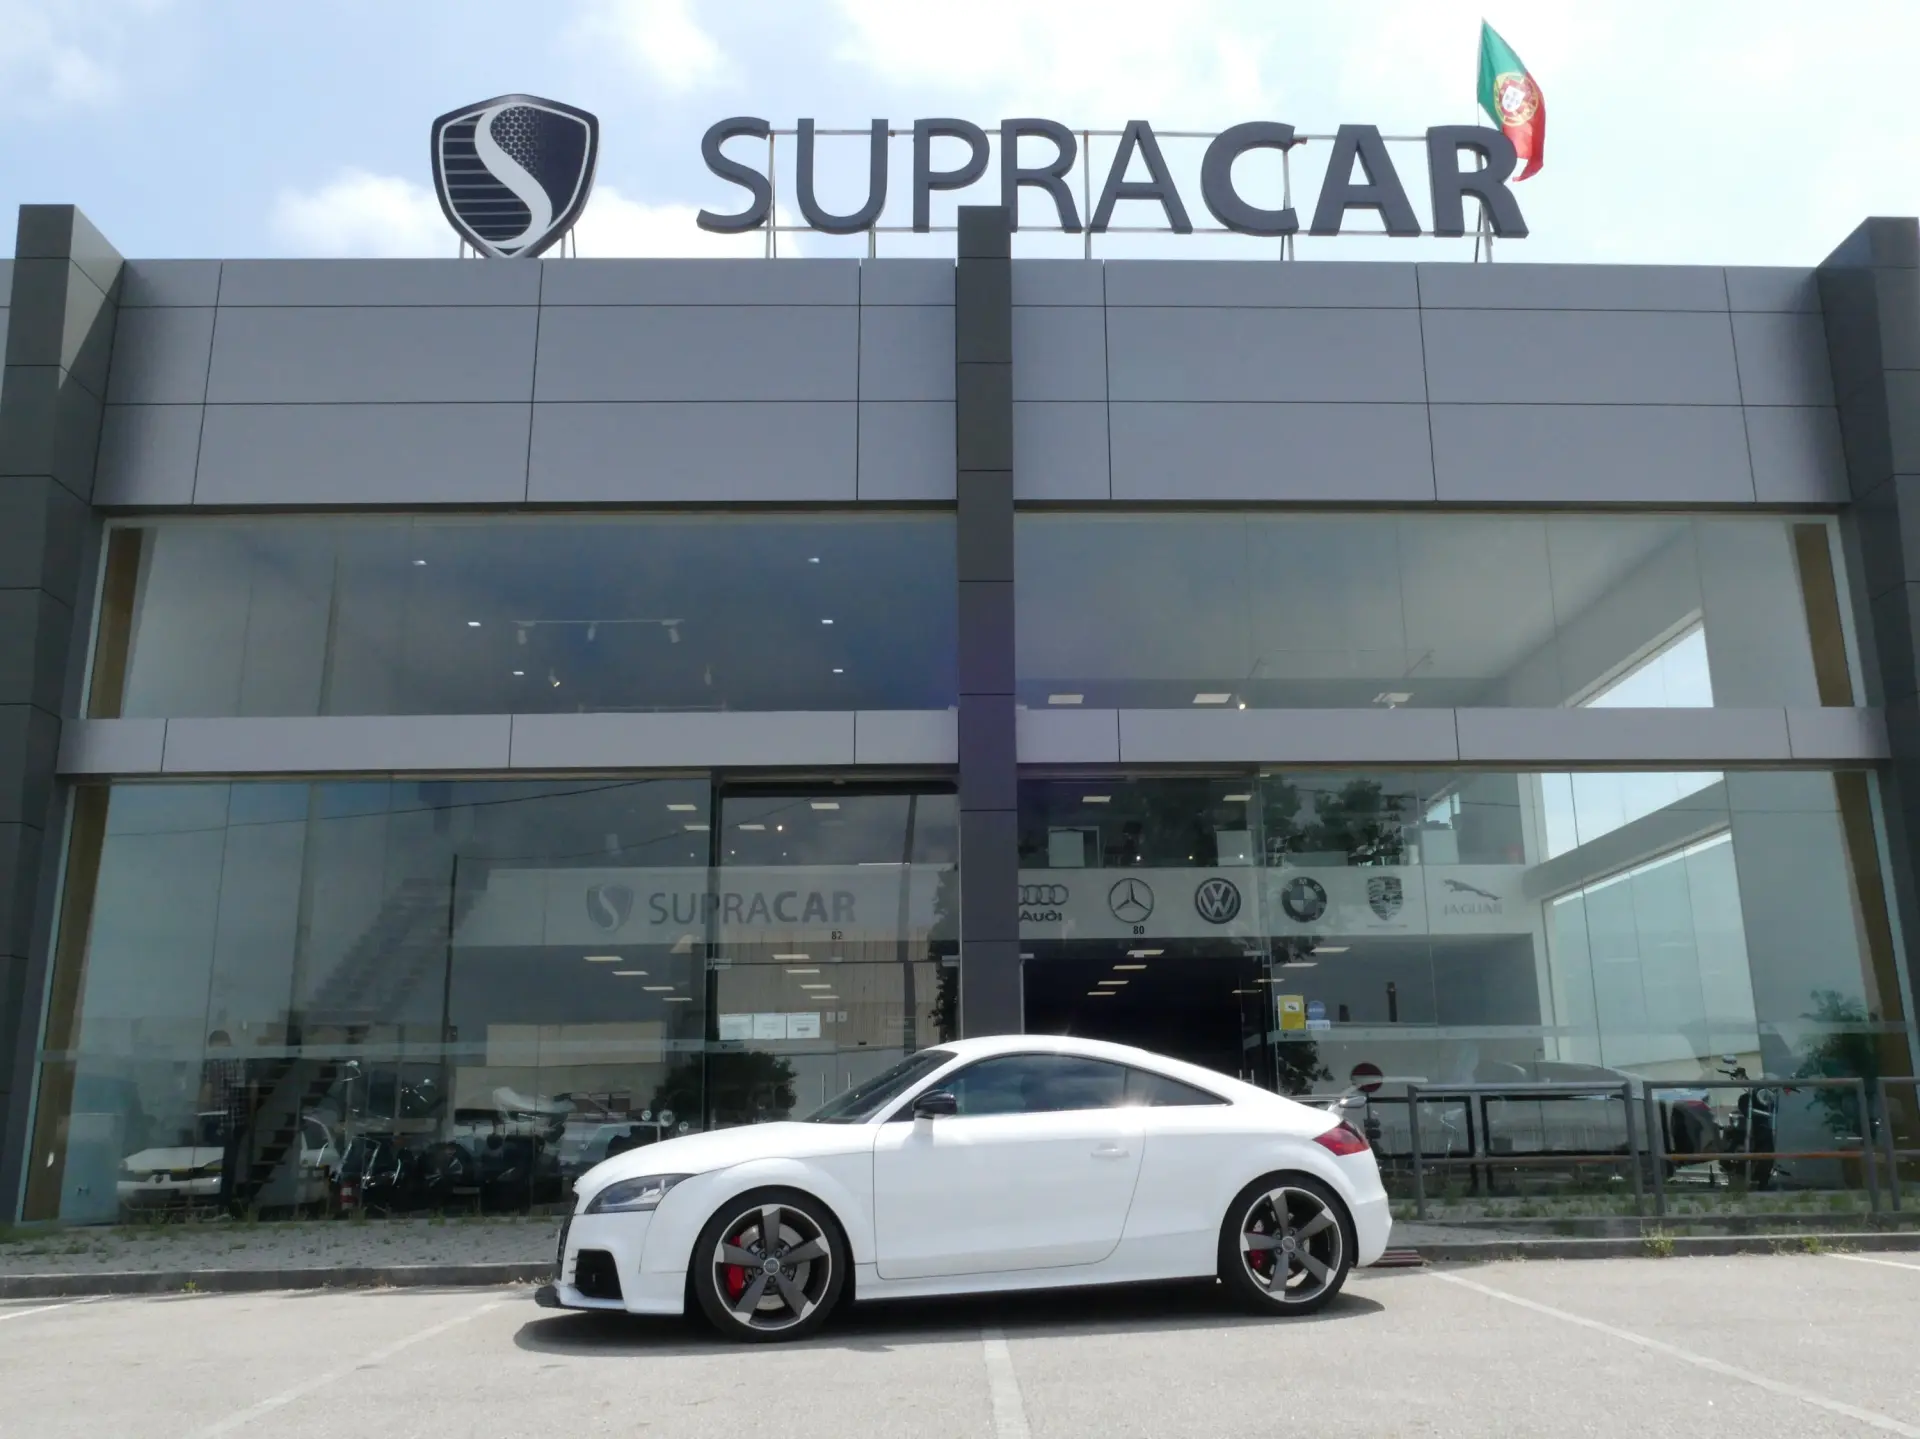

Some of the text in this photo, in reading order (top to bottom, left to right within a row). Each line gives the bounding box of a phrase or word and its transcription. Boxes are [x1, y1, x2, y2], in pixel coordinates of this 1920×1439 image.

[696, 116, 1529, 238] SUPRACAR
[649, 890, 857, 925] SUPRACAR
[831, 930, 843, 940] 82
[1133, 925, 1145, 935] 80
